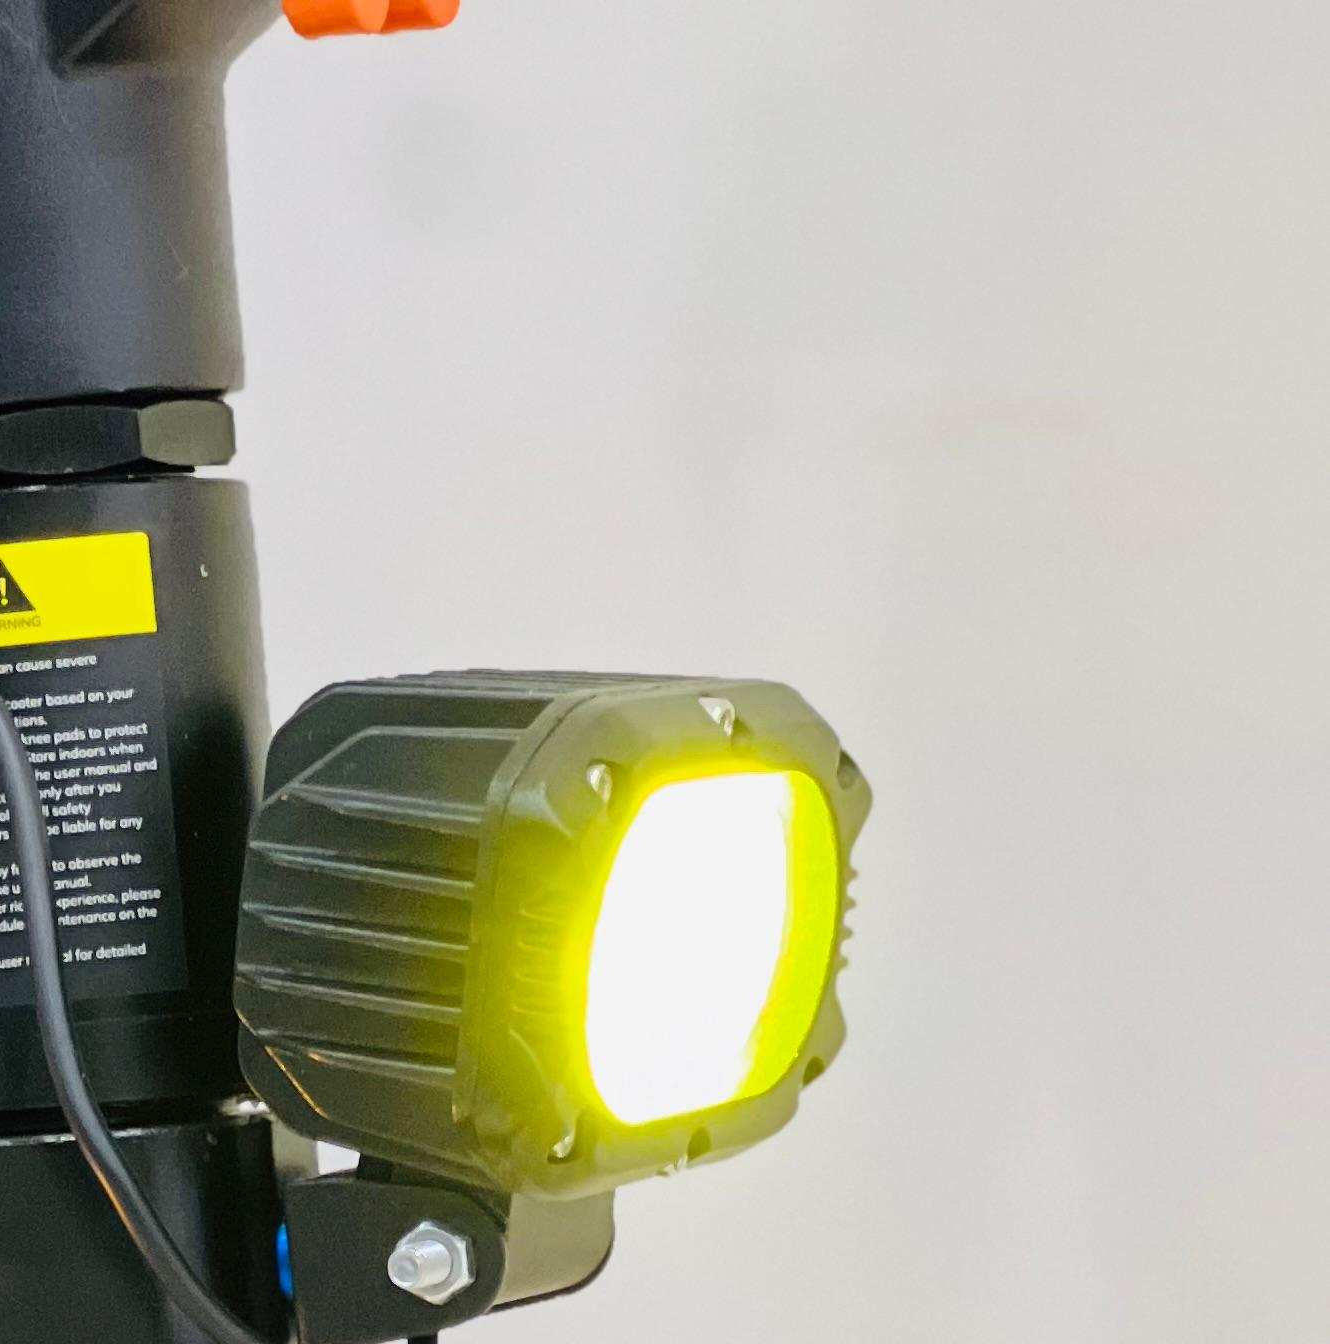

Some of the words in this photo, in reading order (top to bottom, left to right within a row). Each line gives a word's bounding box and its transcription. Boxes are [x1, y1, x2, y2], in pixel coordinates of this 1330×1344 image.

[15, 660, 52, 672] cause
[55, 656, 97, 668] severe
[45, 691, 84, 706] based
[87, 691, 104, 703] on
[106, 688, 133, 703] your
[54, 728, 85, 745] pads
[88, 728, 101, 739] to
[104, 723, 148, 740] protect
[29, 751, 56, 763] tore
[59, 747, 106, 760] indoors
[109, 742, 143, 755] when
[35, 769, 50, 780] he
[53, 768, 80, 780] user
[84, 760, 131, 776] manual
[133, 758, 157, 772] and
[65, 784, 94, 797] after
[97, 783, 121, 797] you
[52, 802, 91, 816] safety
[62, 820, 97, 833] liable
[99, 817, 117, 830] for
[119, 817, 143, 831] any
[52, 860, 66, 871] to
[68, 857, 119, 870] observe
[121, 852, 142, 865] the
[121, 888, 161, 904] please
[119, 909, 135, 920] on
[137, 906, 157, 918] the
[74, 948, 94, 962] for
[96, 943, 147, 959] detailed
